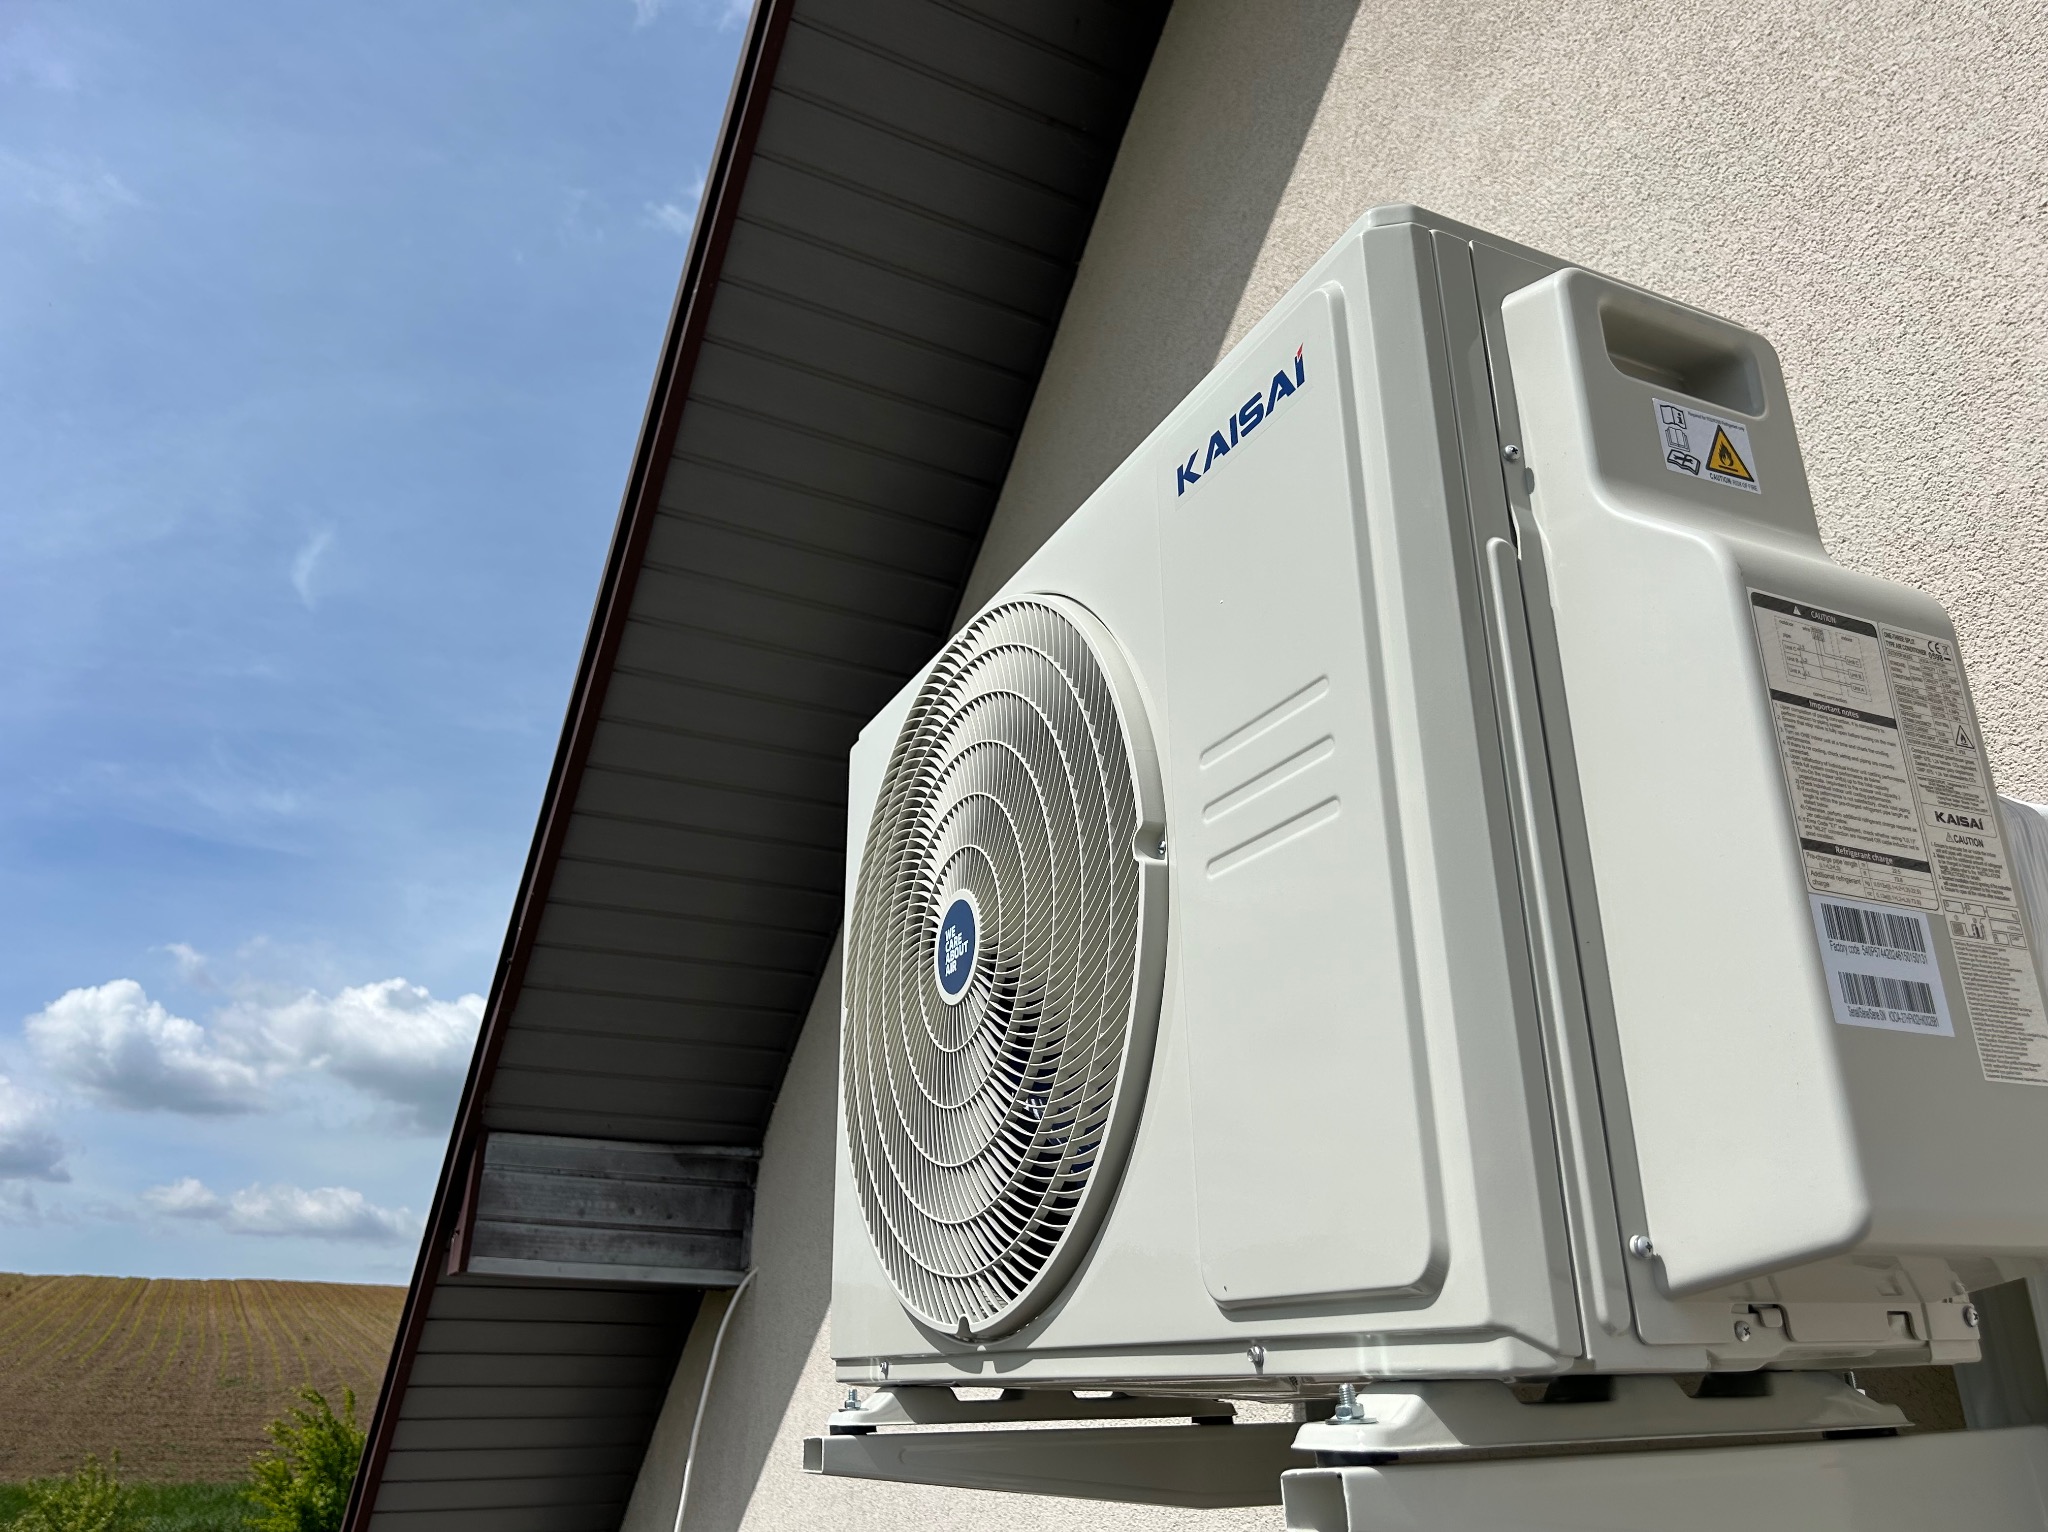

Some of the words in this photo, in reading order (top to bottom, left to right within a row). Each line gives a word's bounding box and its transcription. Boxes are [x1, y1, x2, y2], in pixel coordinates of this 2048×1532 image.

[1177, 343, 1305, 497] KAISAI
[1810, 611, 1837, 624] CAUTION
[1808, 700, 1840, 714] Important
[1841, 708, 1859, 719] notes
[1934, 811, 1984, 830] KAISAI
[1953, 834, 1984, 848] CAUTION
[1835, 846, 1871, 861] Refrigerant
[1871, 852, 1894, 865] charge
[944, 924, 956, 939] WE
[945, 932, 962, 952] CARE
[1830, 940, 1848, 956] Factory
[1848, 944, 1860, 955] code
[944, 940, 968, 966] ABOUT
[945, 961, 958, 978] AIR
